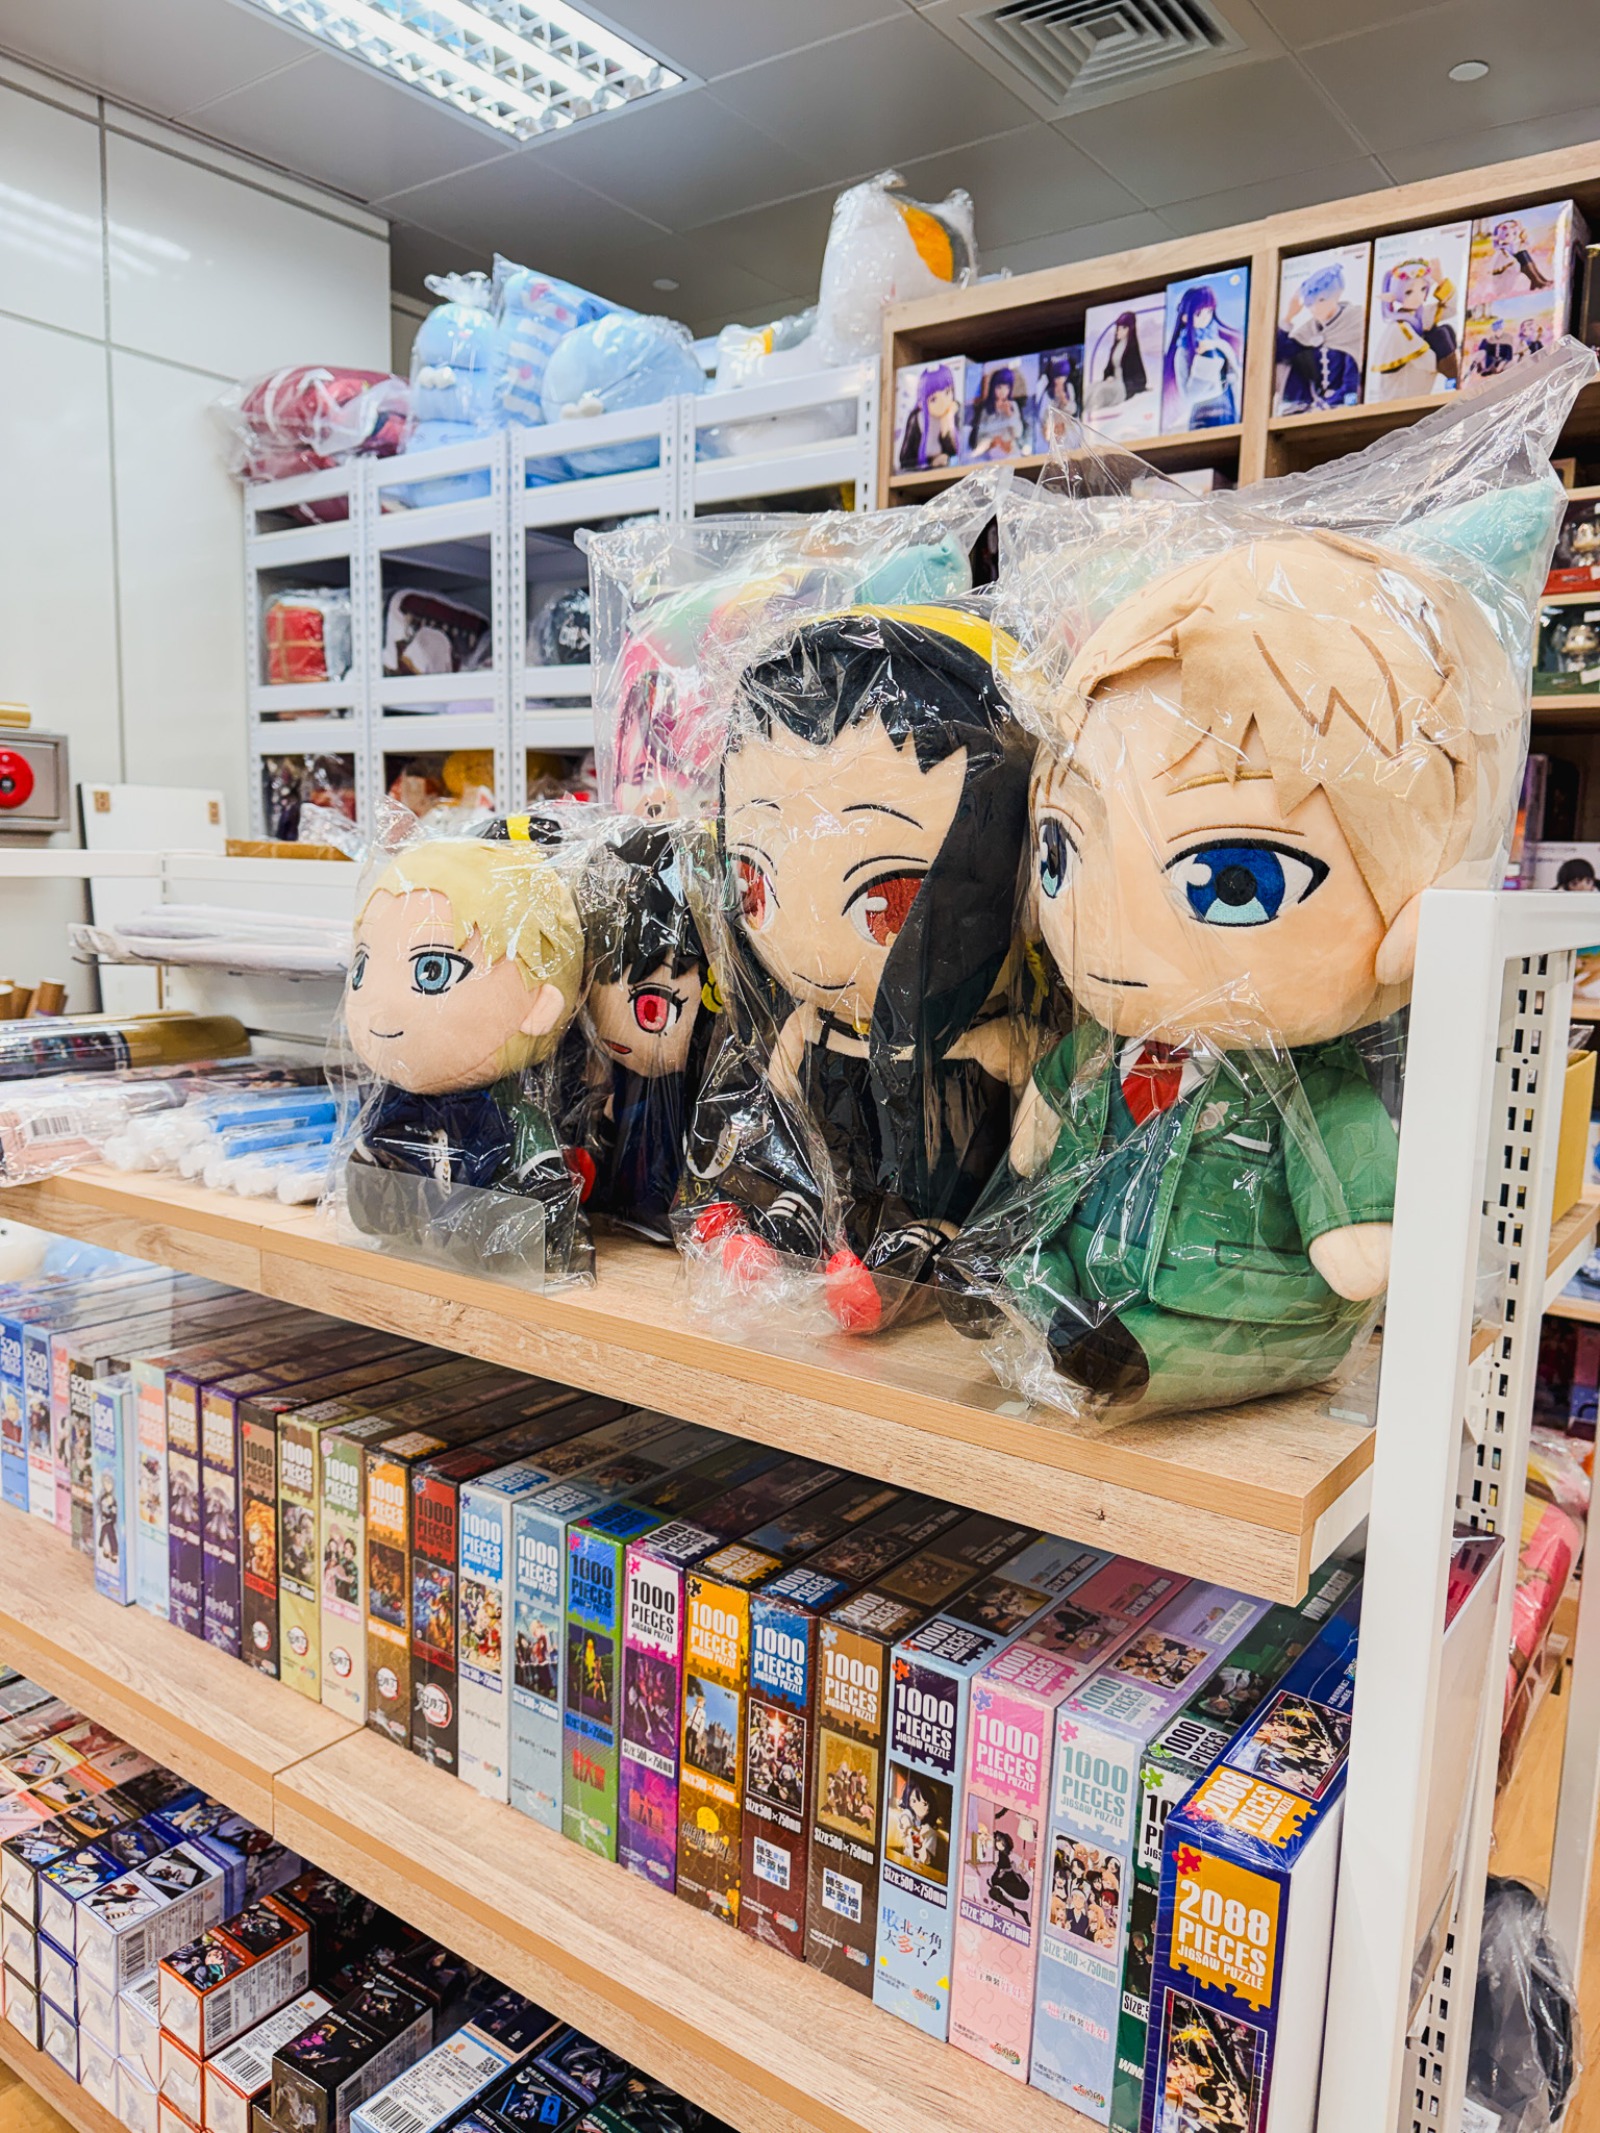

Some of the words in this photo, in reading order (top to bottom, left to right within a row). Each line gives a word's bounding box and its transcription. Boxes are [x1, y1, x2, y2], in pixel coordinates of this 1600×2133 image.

[282, 1440, 312, 1468] 1000
[325, 1457, 358, 1487] 1000
[369, 1477, 404, 1507] 1000
[418, 1496, 452, 1526] 1000
[463, 1512, 501, 1545] 1000
[645, 1523, 688, 1546] 1000
[661, 1531, 702, 1552] PIECES
[464, 1534, 500, 1562] PIECES
[518, 1535, 558, 1569] 1000
[704, 1546, 750, 1571] 1000
[518, 1558, 558, 1587] PIECES
[572, 1554, 613, 1589] 1000
[770, 1568, 816, 1594] 1000
[572, 1578, 611, 1608] PIECES
[631, 1579, 675, 1615] 1000
[790, 1575, 832, 1600] PIECES
[632, 1603, 673, 1634] PIECES
[691, 1601, 738, 1640] 1000
[840, 1592, 885, 1622] 1000
[861, 1602, 902, 1628] PIECES
[691, 1626, 737, 1659] PIECES
[754, 1625, 805, 1665] 1000
[911, 1621, 956, 1650] 1000
[932, 1630, 975, 1658] PIECES
[754, 1650, 803, 1685] PIECES
[825, 1650, 878, 1692] 1000
[990, 1648, 1033, 1679] 1000
[1014, 1657, 1056, 1688] PIECES
[780, 1679, 802, 1695] PUZZLE
[825, 1677, 877, 1714] PIECES
[1080, 1678, 1123, 1709] 1000
[824, 1697, 851, 1714] JIGSAW
[852, 1707, 876, 1724] PUZZLE
[896, 1684, 954, 1728] 1000
[1103, 1687, 1144, 1719] PIECES
[896, 1711, 952, 1751] PIECES
[896, 1732, 923, 1749] JIGSAW
[924, 1742, 951, 1761] PUZZLE
[977, 1715, 1039, 1761] 1000
[1161, 1720, 1206, 1756] 1000
[977, 1742, 1037, 1783] PIECES
[1188, 1731, 1229, 1765] PIECES
[976, 1763, 1006, 1782] JIGSAW
[1007, 1774, 1035, 1794] PUZZLE
[1063, 1747, 1128, 1794] 1000
[1062, 1775, 1125, 1817] PIECES
[1197, 1770, 1254, 1820] 2088
[1233, 1785, 1283, 1833] PIECES
[1061, 1796, 1092, 1816] JIGSAW
[1094, 1808, 1123, 1827] PUZZLE
[1179, 1879, 1271, 1947] 2088
[1178, 1917, 1267, 1978] PIECES
[1177, 1945, 1221, 1971] JIGSAW
[1223, 1961, 1264, 1991] PUZZLE
